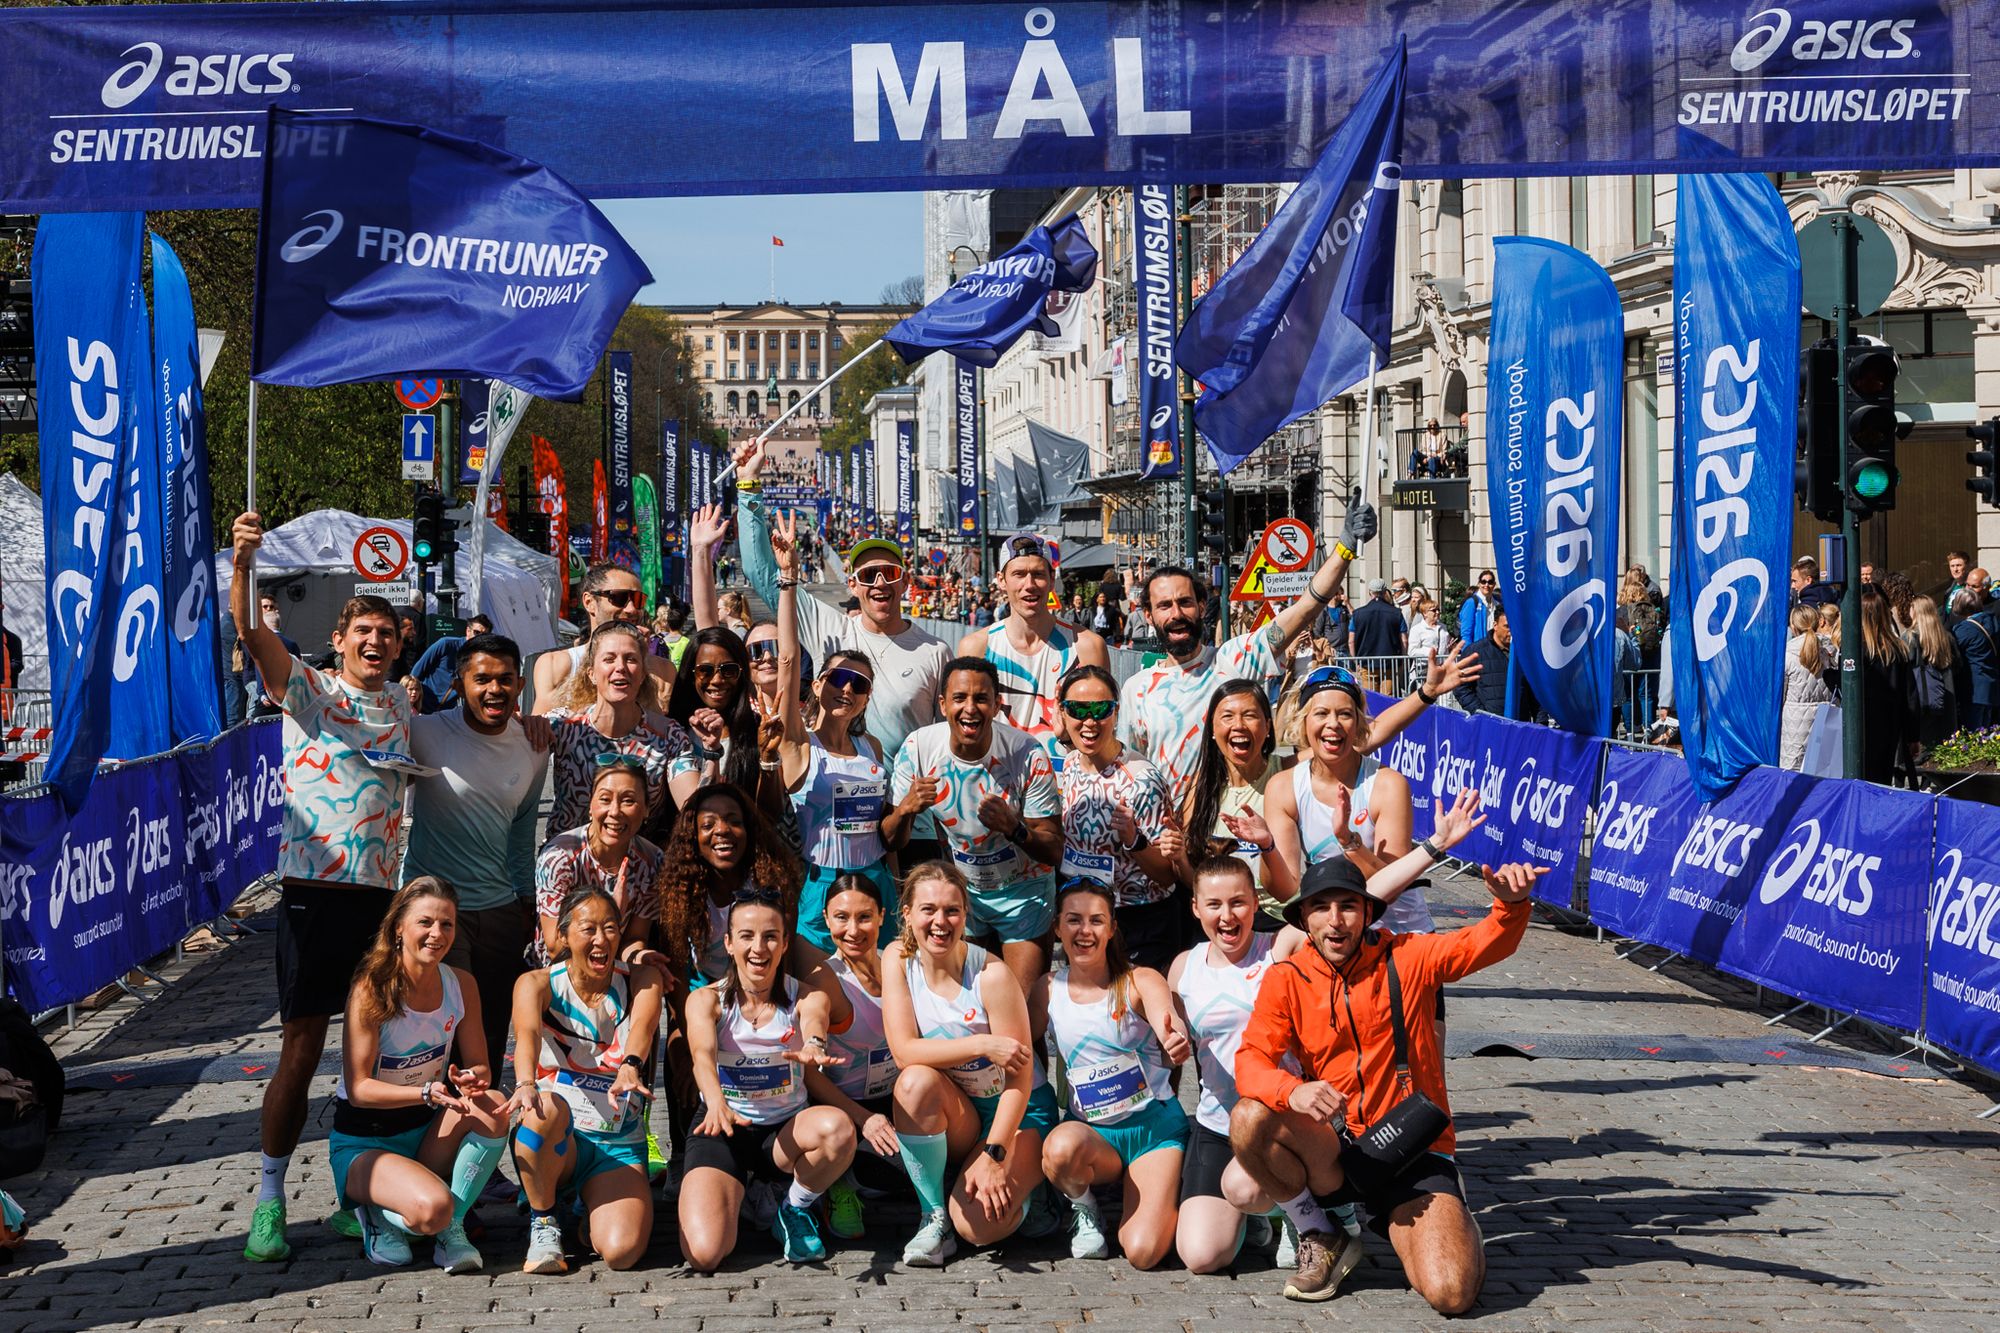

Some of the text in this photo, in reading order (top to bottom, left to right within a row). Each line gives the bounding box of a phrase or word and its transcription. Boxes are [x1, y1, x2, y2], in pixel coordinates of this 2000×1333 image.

[1793, 19, 1915, 60] asics
[165, 53, 294, 96] asics
[851, 7, 1191, 142] MÅL
[1677, 87, 1970, 125] SENTRUMSLØPET
[357, 226, 608, 278] FRONTRUNNER
[501, 282, 590, 309] NORWAY
[615, 368, 628, 487] SENTRUMSLØPET
[959, 368, 976, 488] SENTRUMSLØPET
[666, 430, 677, 513] SENTRUMSLØPET
[899, 432, 910, 514] SENTRUMSLØPET
[1403, 490, 1437, 505] HOTEL
[356, 585, 406, 596] Gjelder ikke
[1266, 576, 1293, 586] Gjelder
[1267, 585, 1306, 593] Varelever
[1239, 841, 1259, 850] sics
[1802, 843, 1882, 916] asics
[1941, 876, 2000, 960] asic
[1823, 937, 1858, 962] sound
[1859, 943, 1900, 975] body
[747, 1057, 770, 1066] asics
[1098, 1064, 1120, 1077] asics
[771, 1087, 787, 1096] XXL
[1098, 1083, 1122, 1096] Viktoria
[1130, 1092, 1147, 1105] XXL
[1373, 1122, 1403, 1150] JBL
